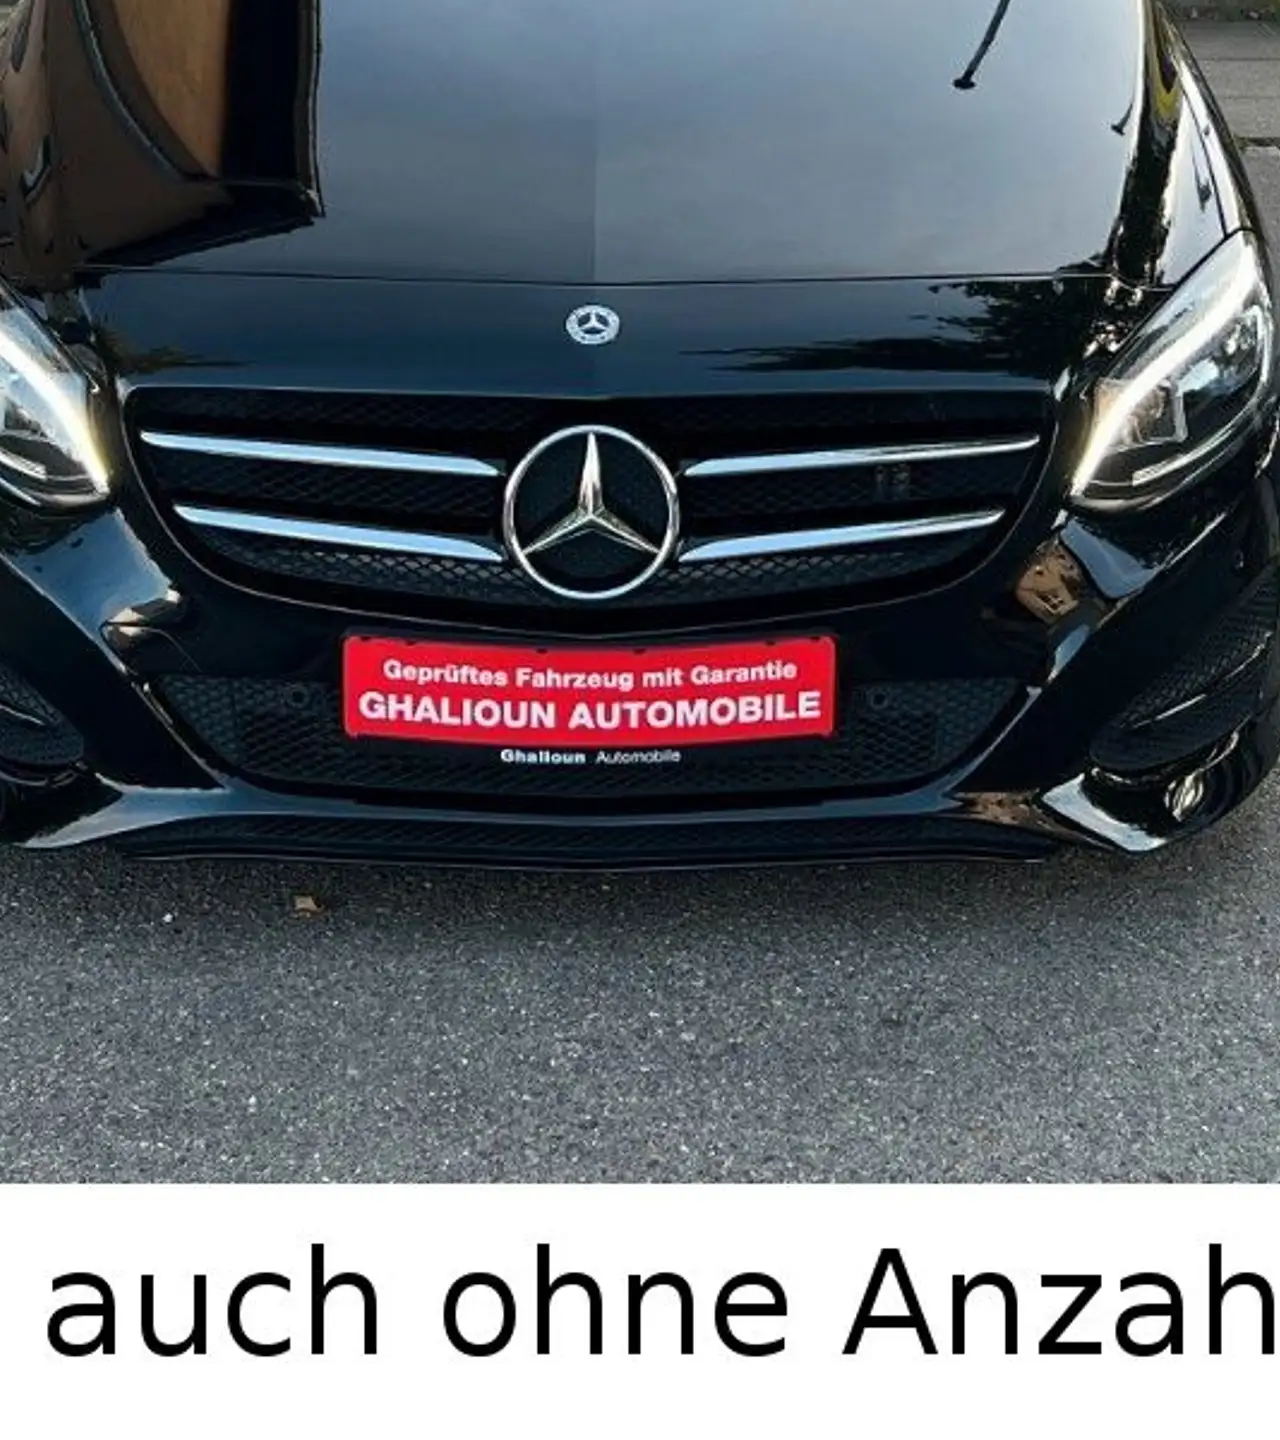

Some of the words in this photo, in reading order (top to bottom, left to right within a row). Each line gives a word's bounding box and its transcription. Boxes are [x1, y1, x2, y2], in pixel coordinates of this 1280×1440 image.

[382, 659, 508, 688] Geprüftes
[515, 666, 634, 693] Fahrzeug
[642, 666, 683, 688] mit
[690, 660, 797, 687] Garantie
[358, 691, 556, 729] GHALIOUN
[568, 691, 822, 729] AUTOMOBILE
[500, 748, 586, 764] Ghalioun
[595, 748, 681, 765] Automobile
